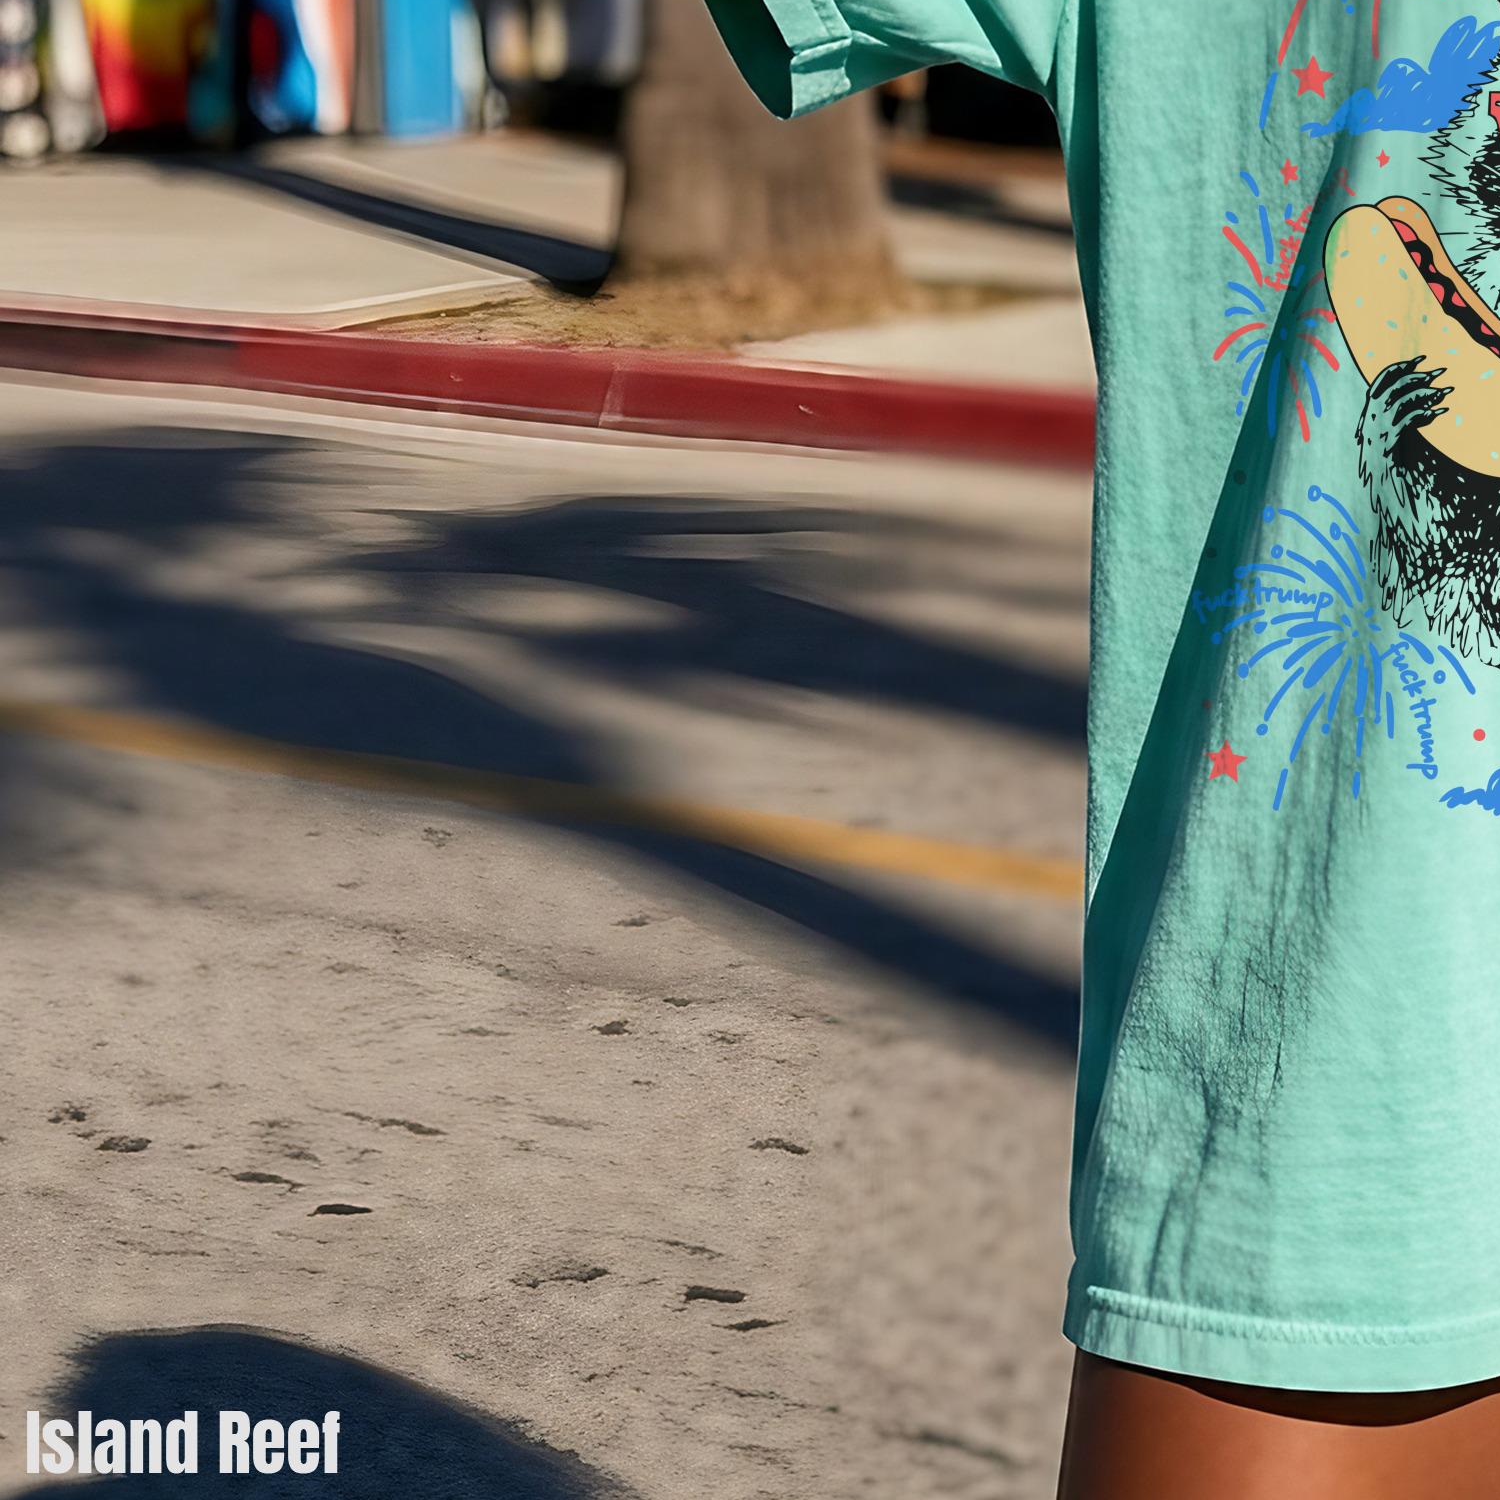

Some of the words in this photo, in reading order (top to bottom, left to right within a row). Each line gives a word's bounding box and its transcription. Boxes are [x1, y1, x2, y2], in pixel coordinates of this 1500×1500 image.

[1252, 576, 1334, 622] trump
[1381, 641, 1427, 698] fuck
[1406, 698, 1439, 780] trump
